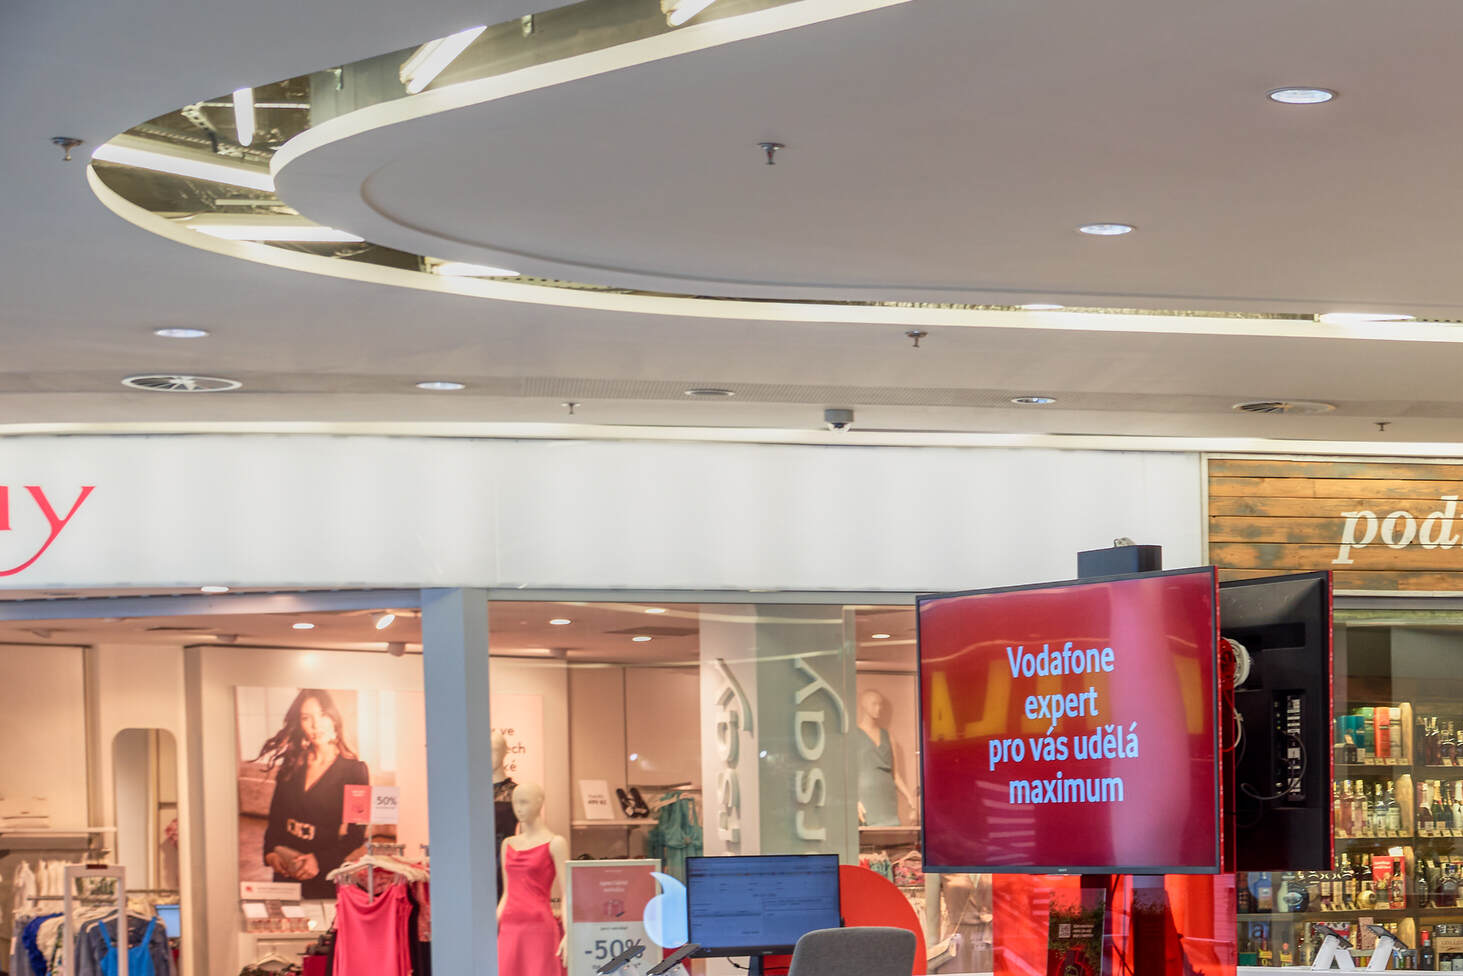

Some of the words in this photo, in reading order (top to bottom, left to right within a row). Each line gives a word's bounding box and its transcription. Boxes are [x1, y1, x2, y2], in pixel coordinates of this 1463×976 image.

[1006, 642, 1115, 678] Vodafone
[1024, 686, 1099, 727] expert
[794, 657, 849, 858] rsay
[988, 737, 1026, 772] pro
[1029, 726, 1069, 762] vás
[1073, 721, 1139, 760] udělá
[1009, 771, 1125, 804] maximum
